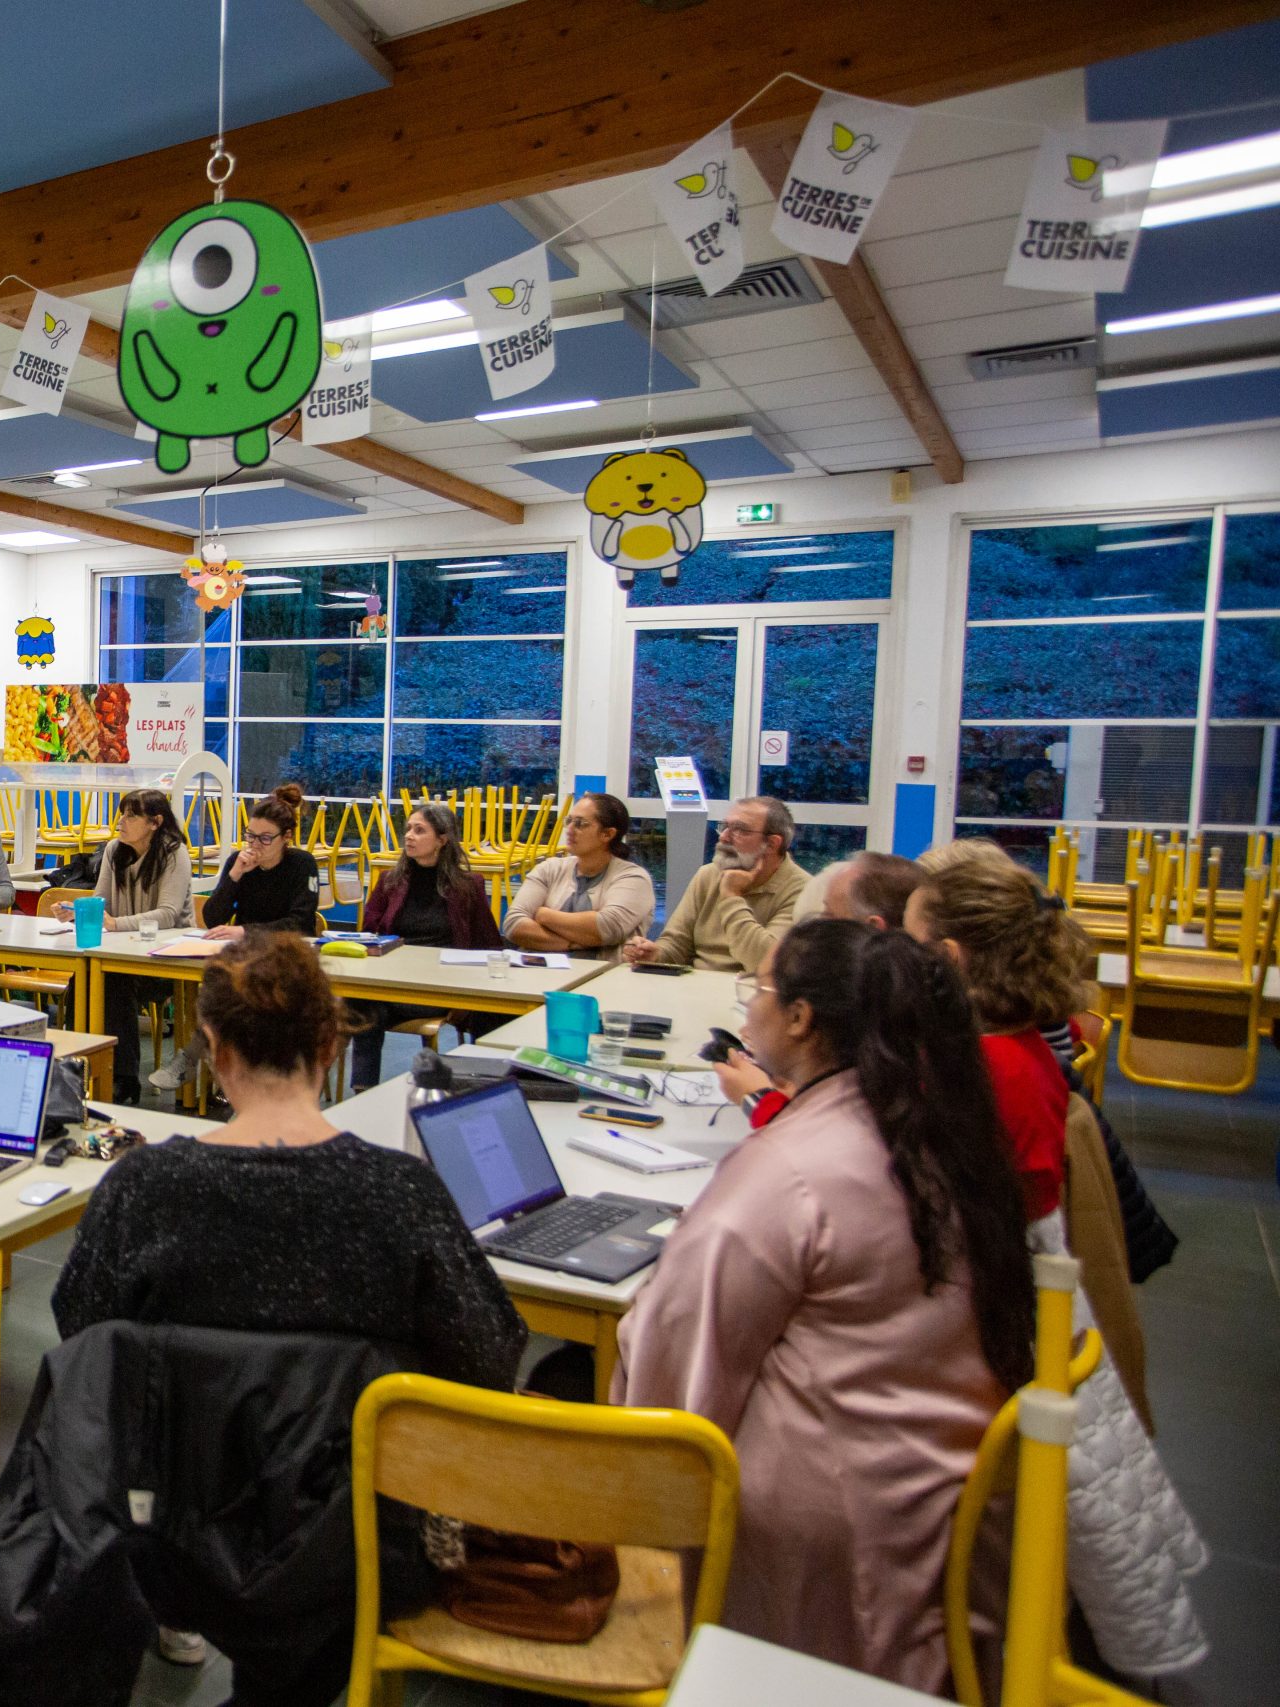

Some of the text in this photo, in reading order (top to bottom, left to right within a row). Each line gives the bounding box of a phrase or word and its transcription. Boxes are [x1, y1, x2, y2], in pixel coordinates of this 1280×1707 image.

[790, 177, 860, 213] TERRES
[781, 196, 864, 234] CUISINE
[1019, 239, 1129, 260] CUISINE
[486, 319, 548, 357] TERRES
[490, 329, 552, 372] CUISINE
[19, 351, 62, 377] TERRES
[12, 364, 65, 392] CUISINE
[306, 393, 369, 419] CUISINE
[309, 381, 363, 405] TERRES
[136, 719, 186, 731] LES PLATS
[146, 729, 189, 755] chauds
